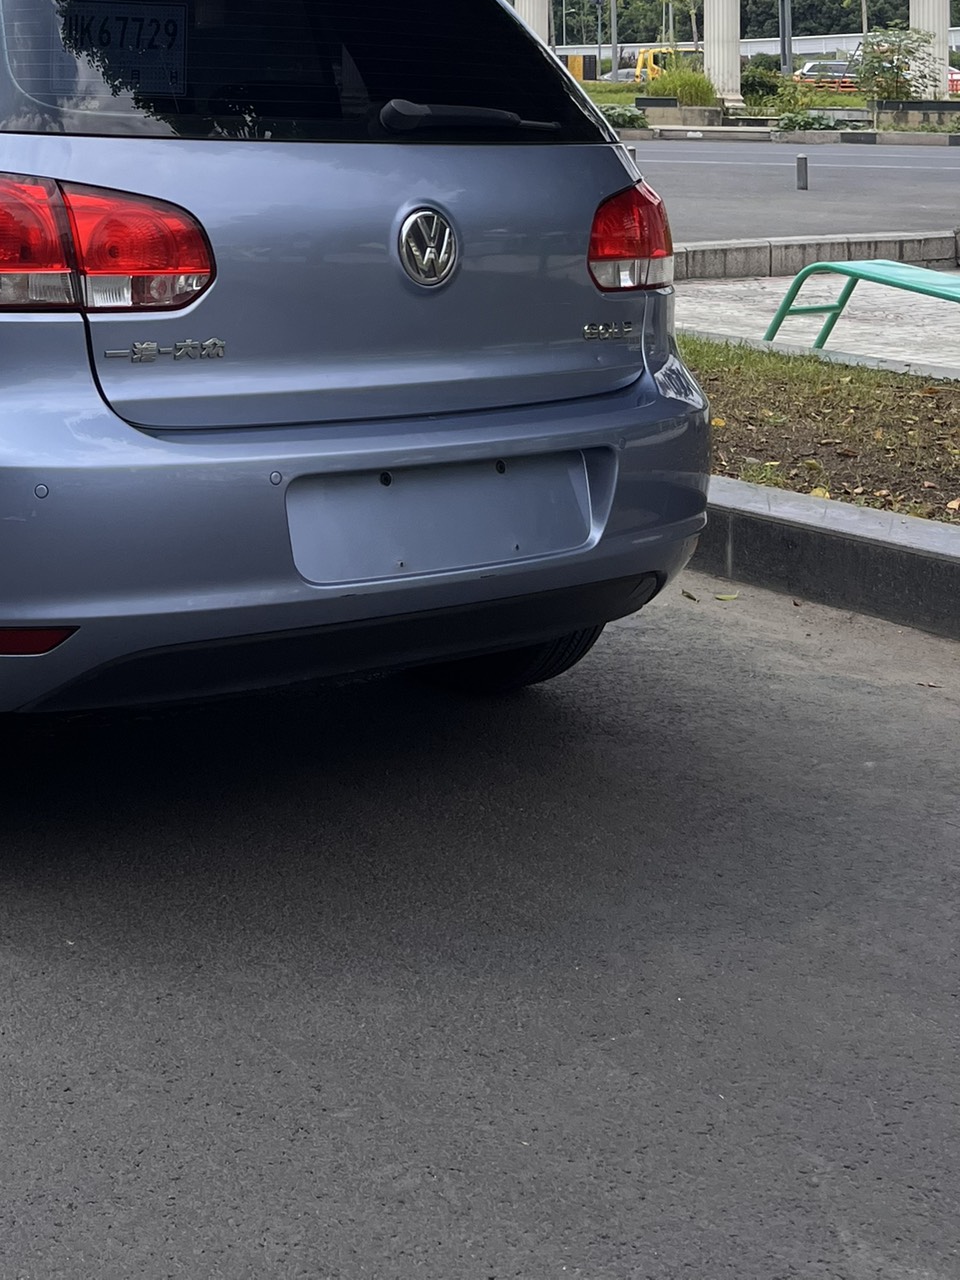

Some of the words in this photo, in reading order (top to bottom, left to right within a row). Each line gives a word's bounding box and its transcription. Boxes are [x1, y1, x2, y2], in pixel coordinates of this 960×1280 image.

[399, 208, 456, 286] VW
[104, 338, 226, 363] 一汽-大众
